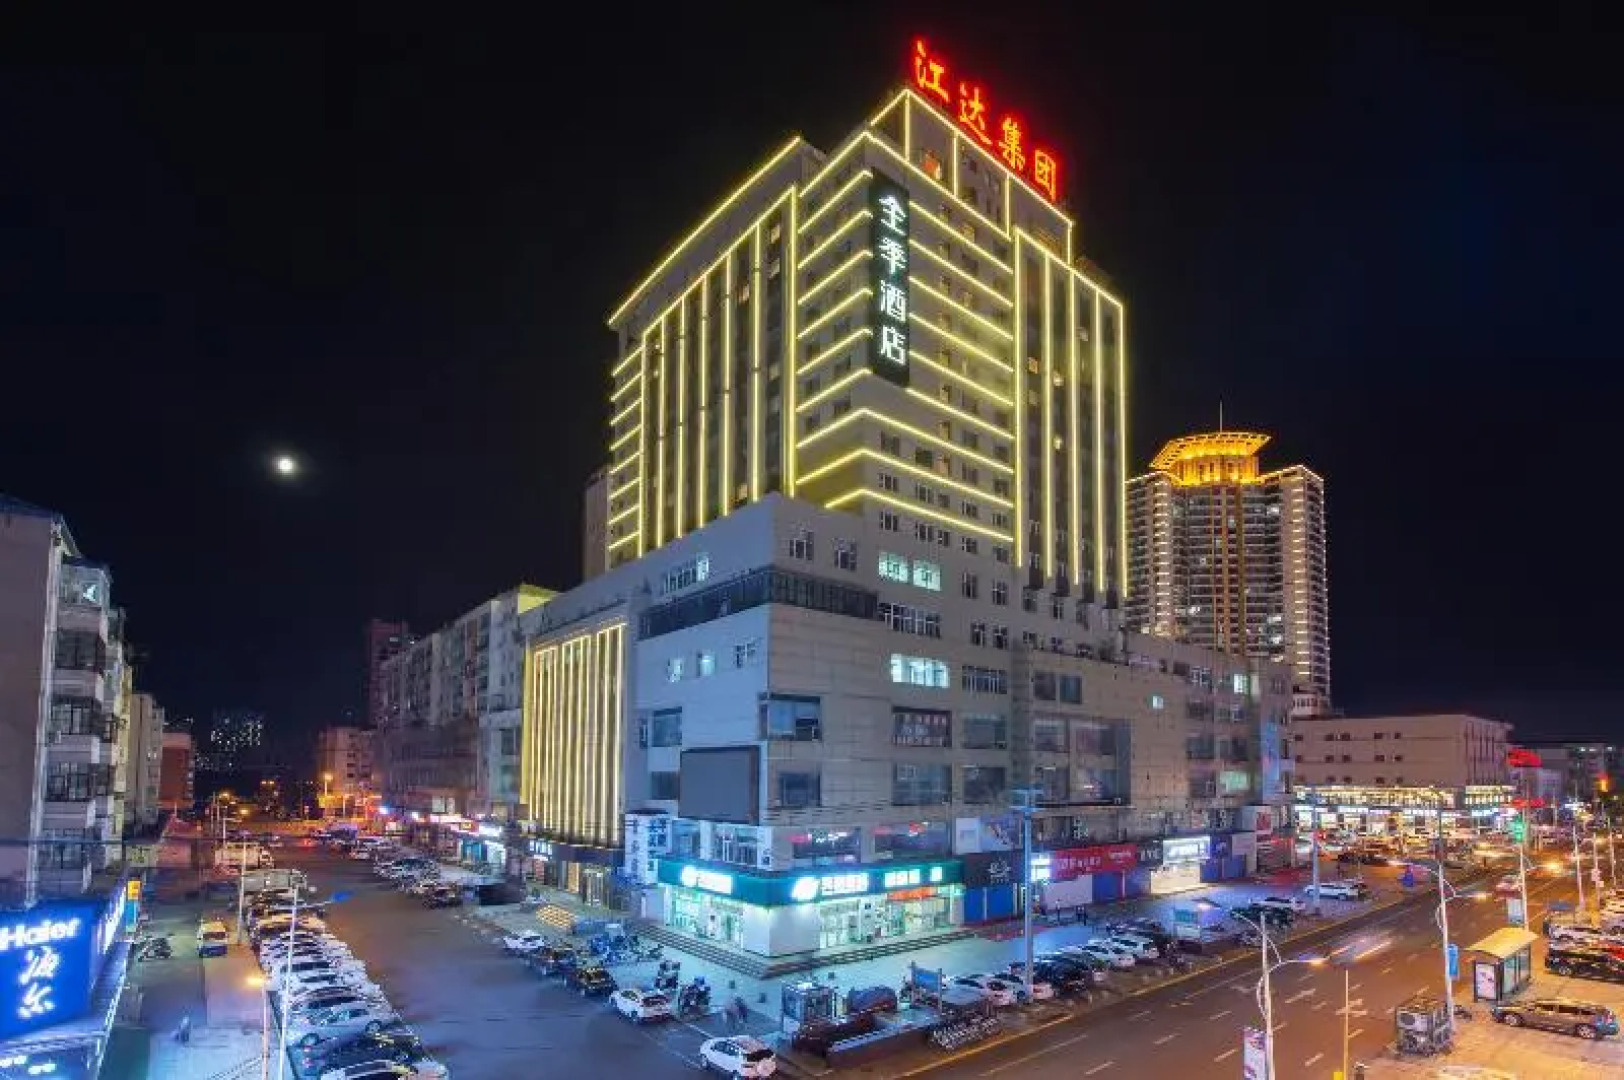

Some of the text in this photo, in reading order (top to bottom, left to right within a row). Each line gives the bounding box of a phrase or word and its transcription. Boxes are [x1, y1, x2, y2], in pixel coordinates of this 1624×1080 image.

[914, 40, 1058, 201] 江达集团
[877, 194, 908, 366] 全季酒店
